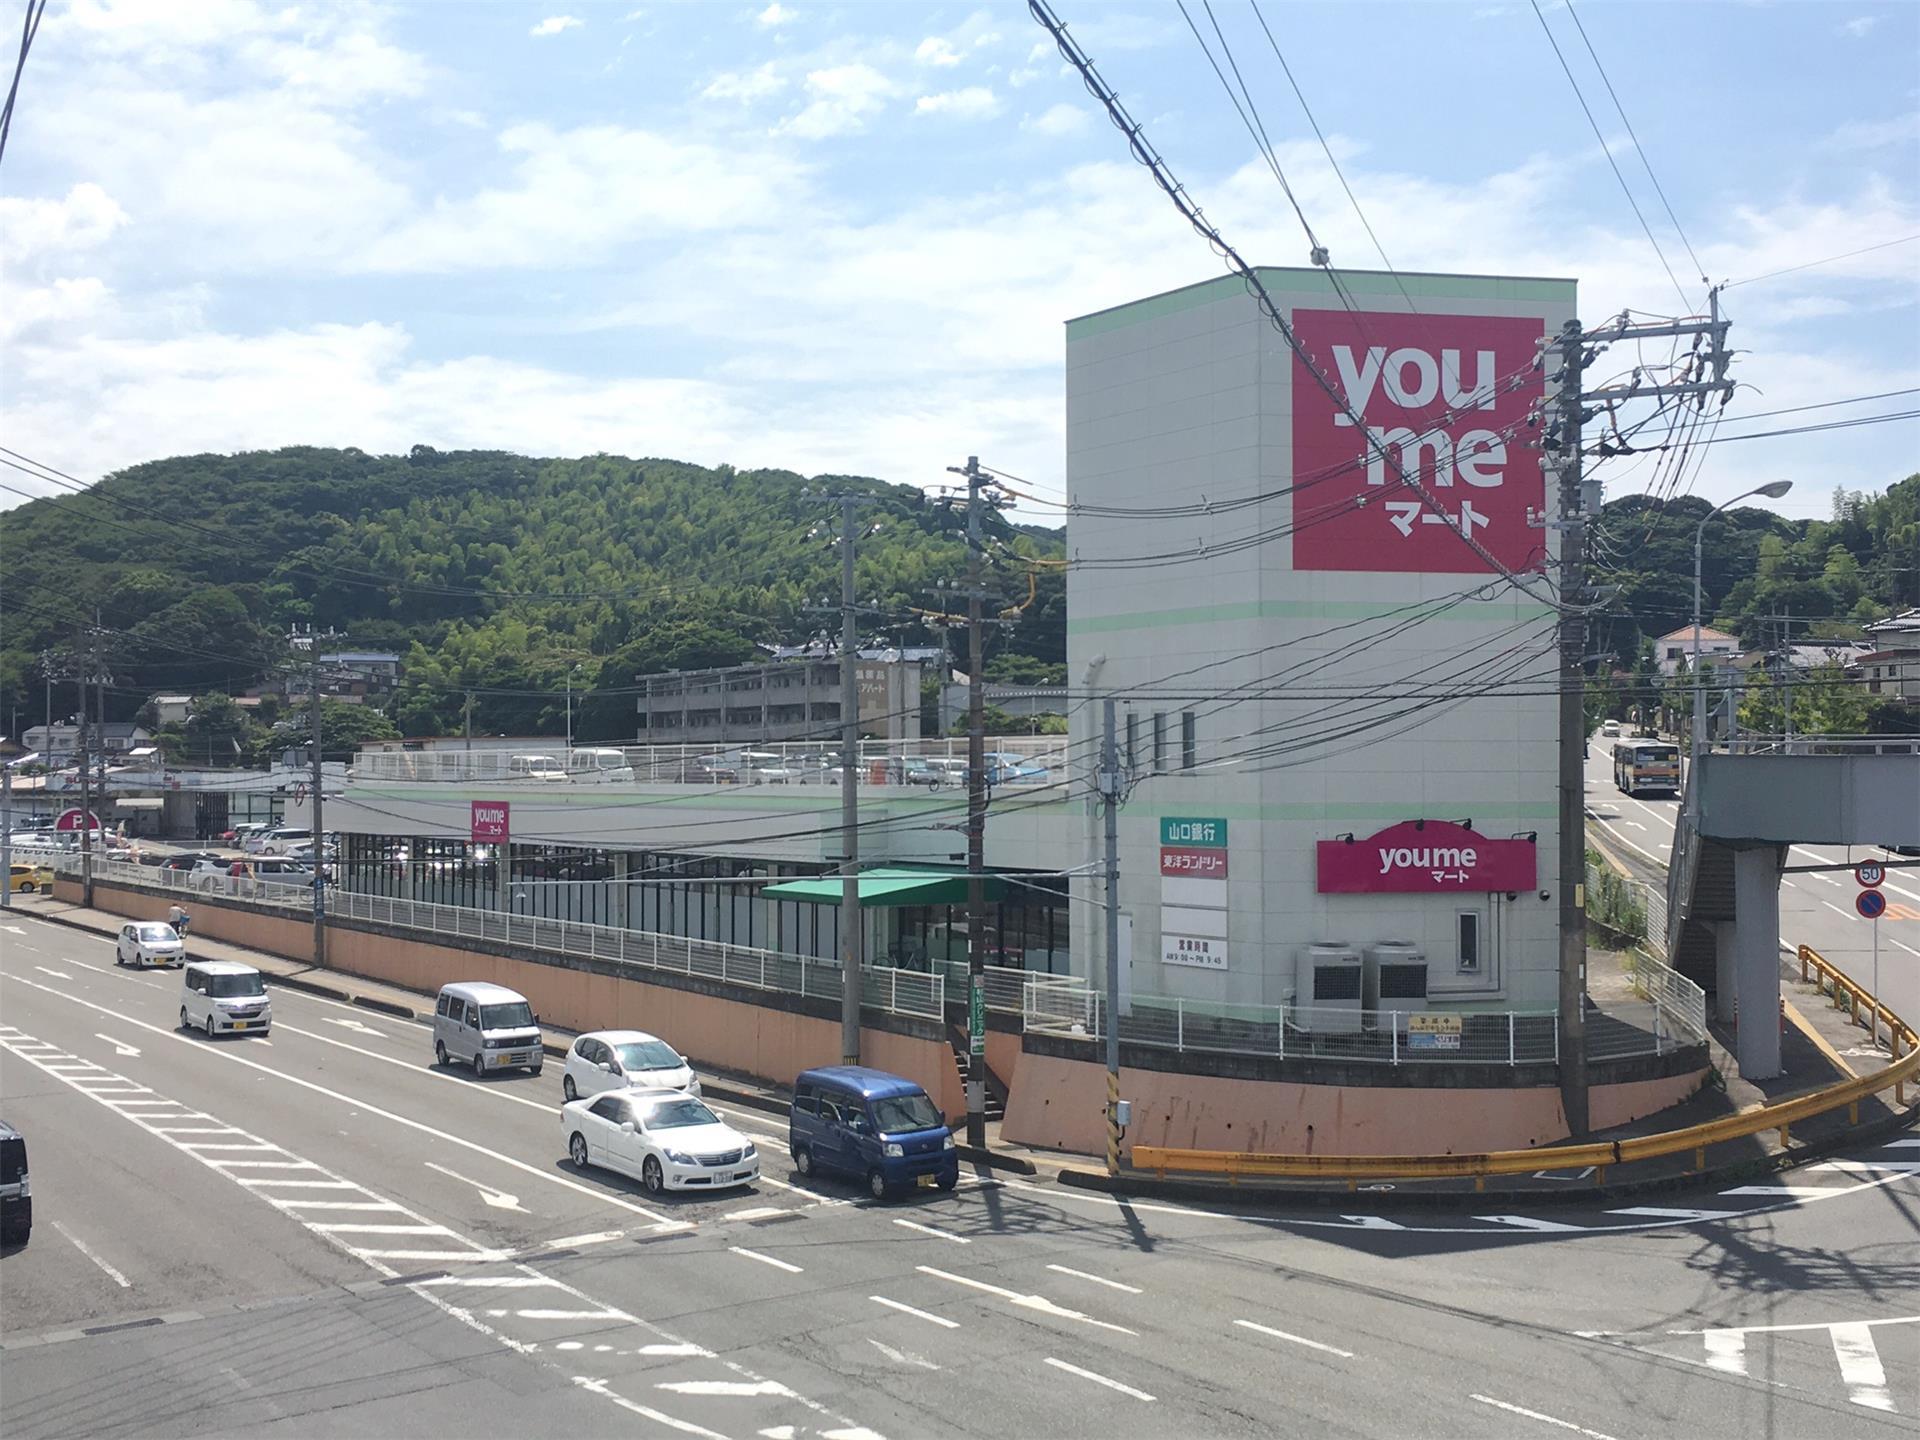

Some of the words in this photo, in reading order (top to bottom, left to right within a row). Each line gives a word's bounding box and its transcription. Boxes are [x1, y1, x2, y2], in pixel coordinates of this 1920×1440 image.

[1331, 345, 1496, 427] you
[1366, 425, 1508, 488] me
[1385, 500, 1490, 538] マート
[72, 814, 83, 829] P
[475, 808, 504, 826] youme
[1168, 822, 1215, 842] 山口銀行
[1163, 855, 1222, 870] 東洋ランドリー
[1378, 847, 1477, 874] youme
[1431, 869, 1470, 884] マート
[1862, 867, 1878, 879] 50
